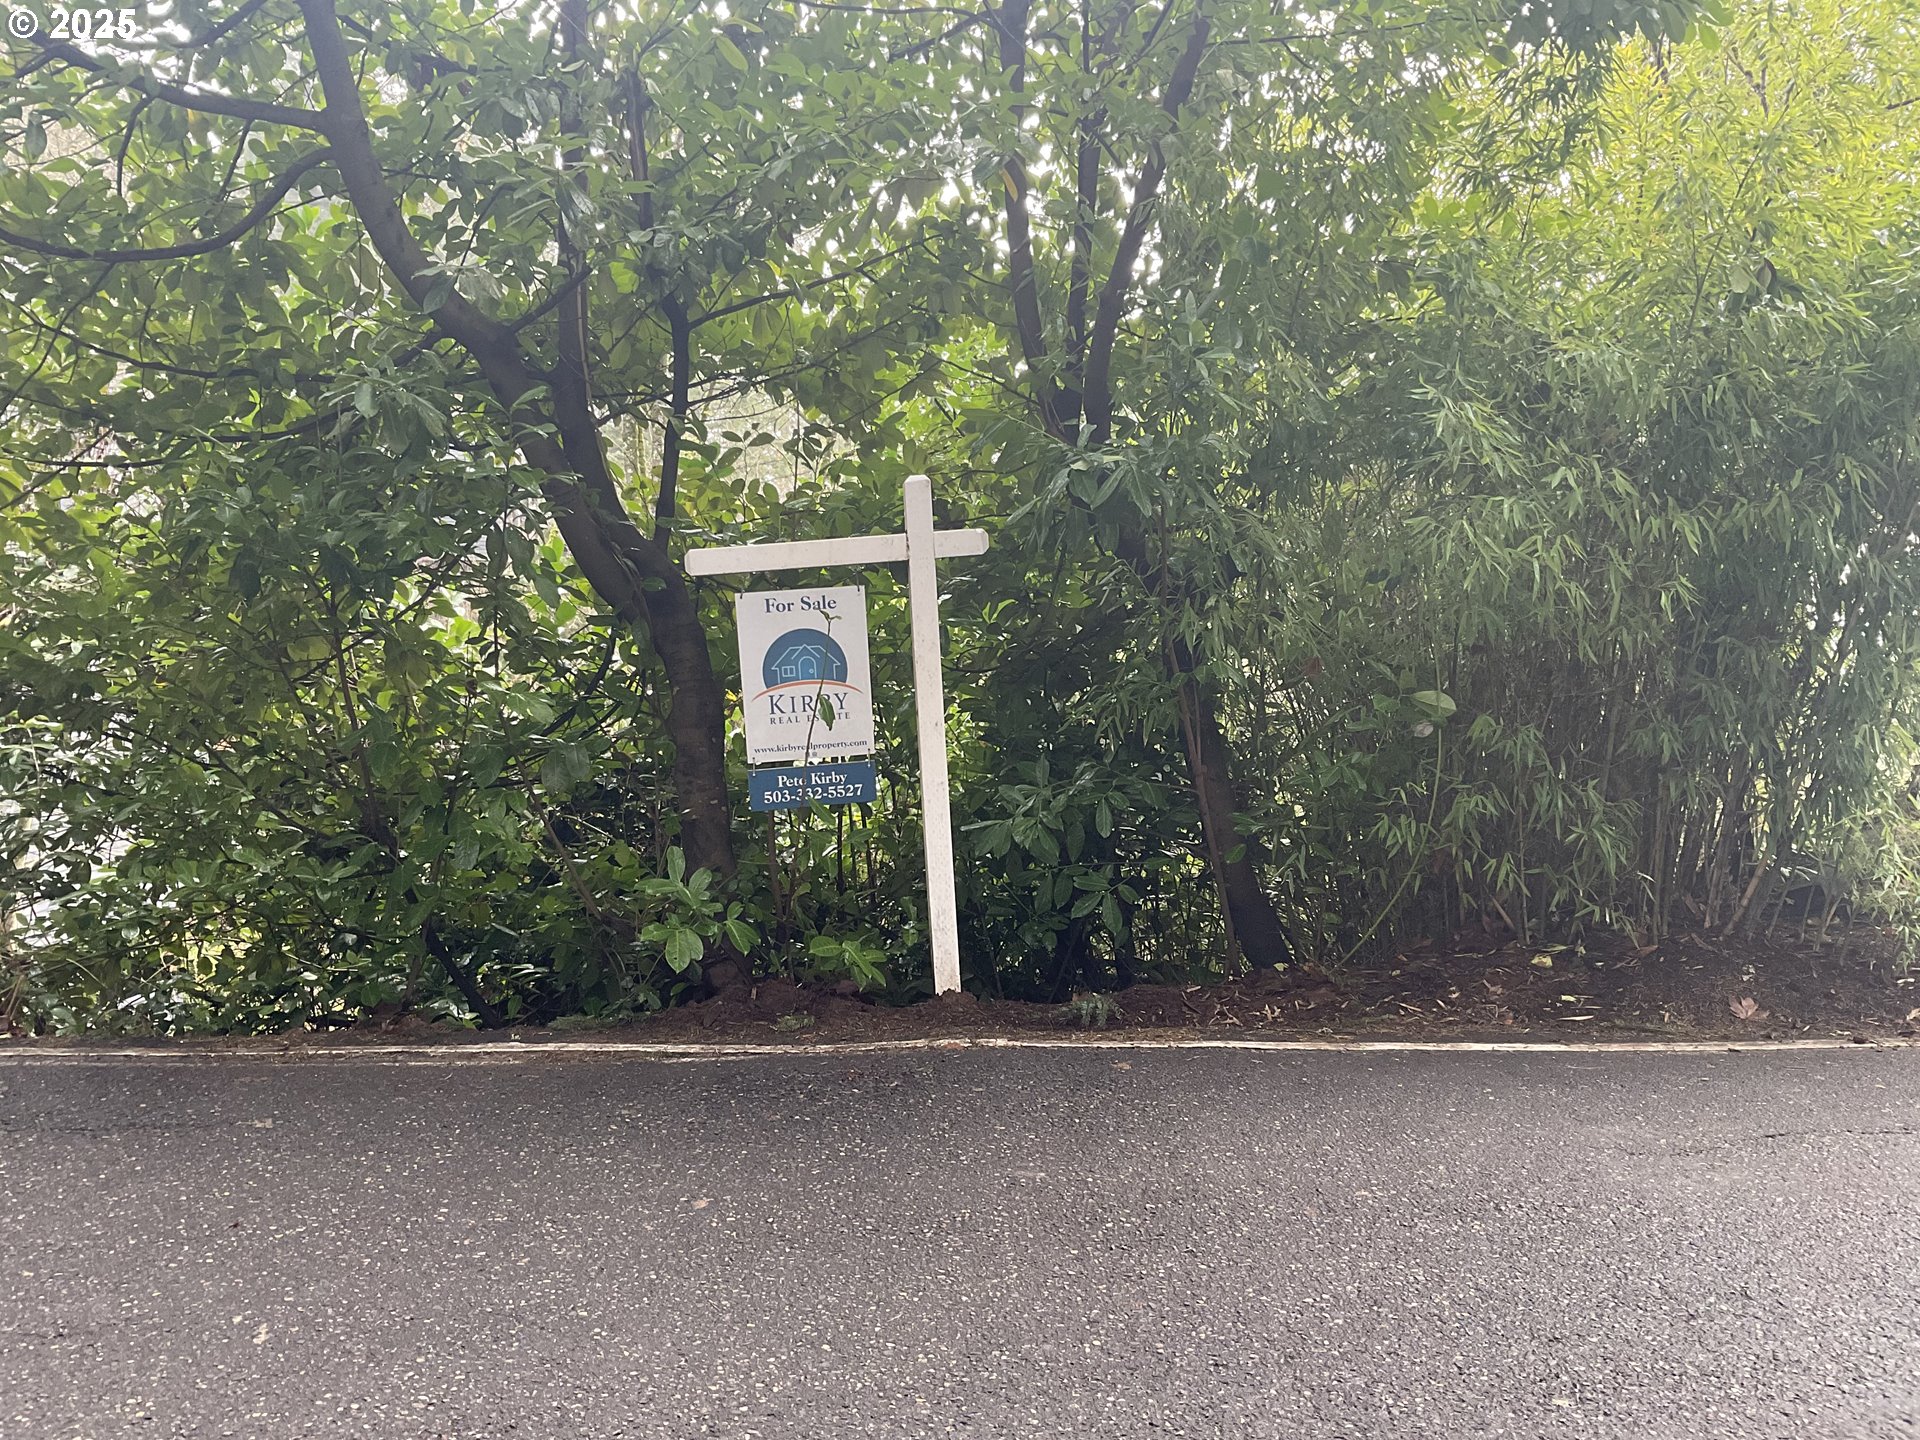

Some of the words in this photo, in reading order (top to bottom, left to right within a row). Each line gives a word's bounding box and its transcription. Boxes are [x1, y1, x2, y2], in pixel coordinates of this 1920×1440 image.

[764, 597, 795, 614] For
[800, 594, 837, 611] Sale
[768, 692, 848, 715] KIRY
[770, 715, 801, 725] REAL
[807, 711, 851, 722] ESTE
[754, 739, 868, 754] www.kirbyrelproperty.com
[810, 771, 848, 786] Kirby
